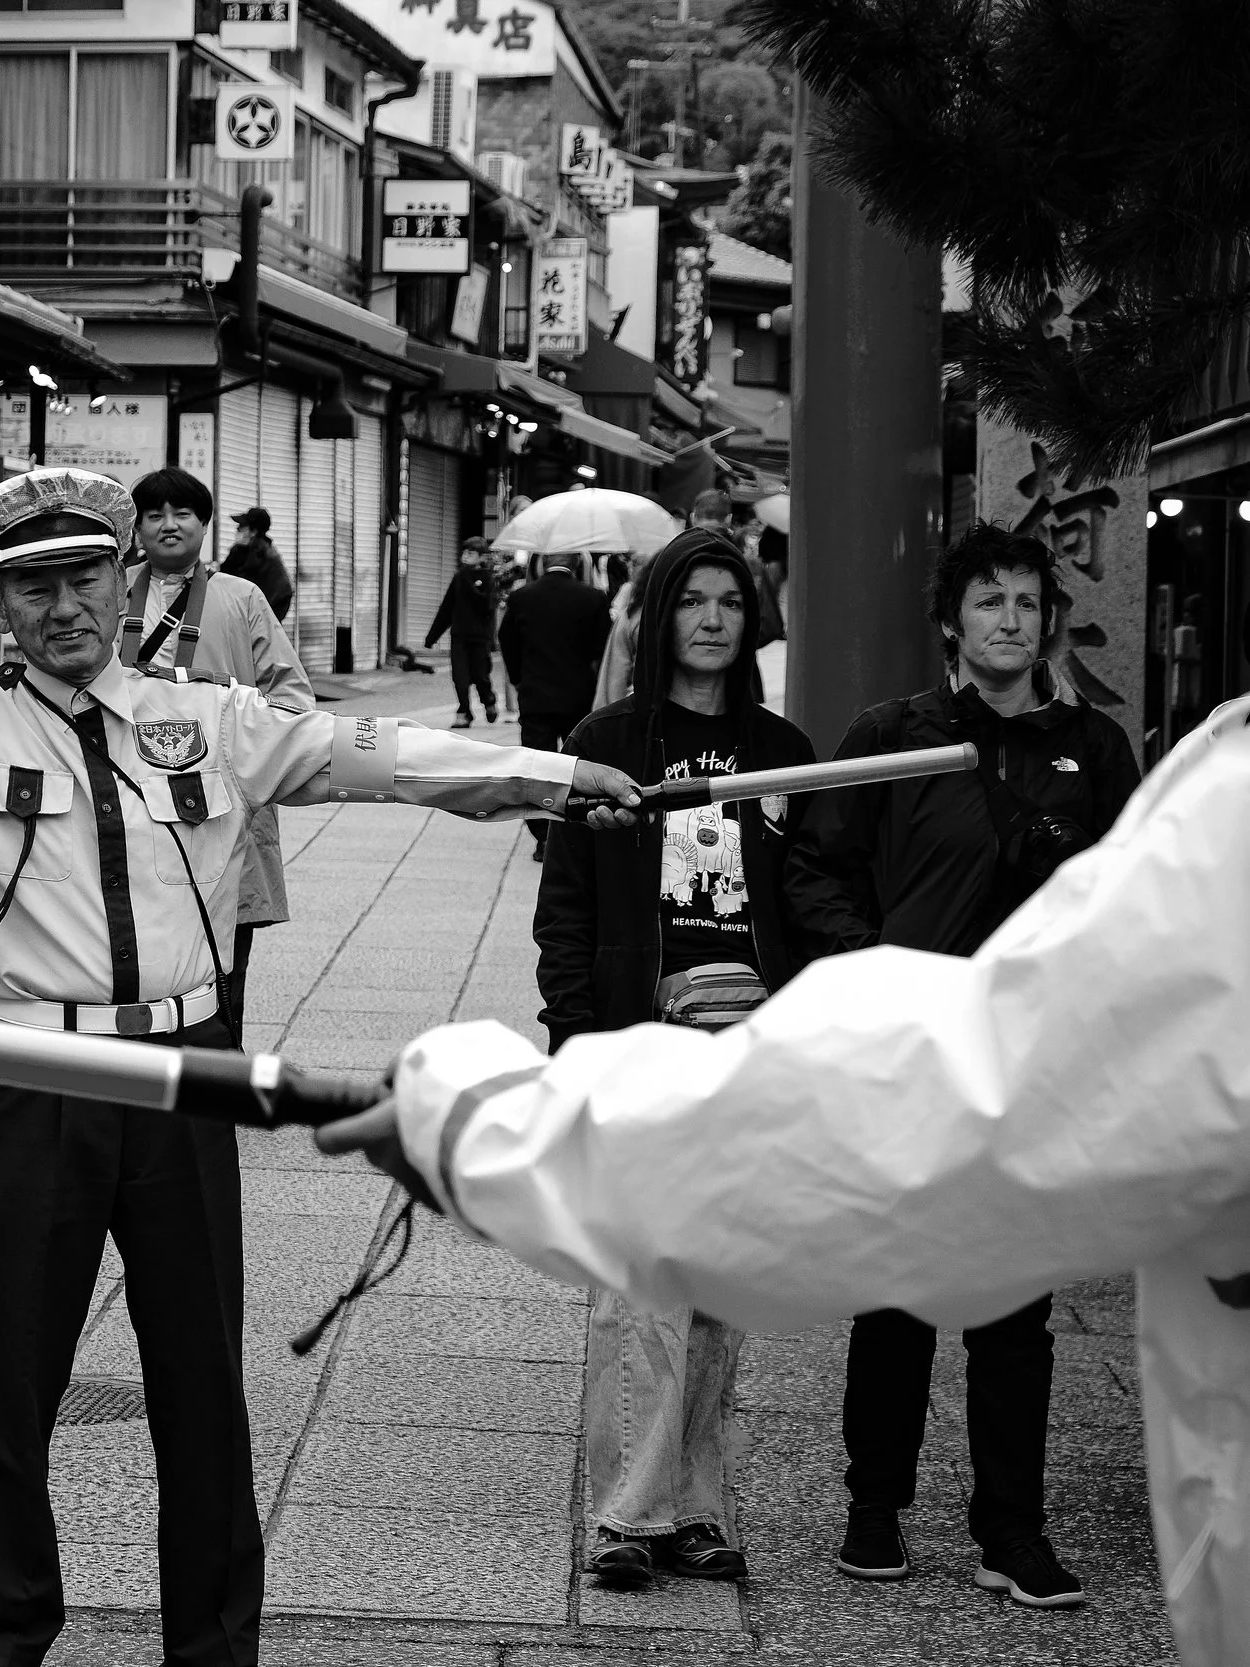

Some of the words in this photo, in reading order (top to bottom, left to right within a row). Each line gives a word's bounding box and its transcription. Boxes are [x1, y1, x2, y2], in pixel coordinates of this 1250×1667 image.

[391, 214, 462, 238] 日野家
[138, 723, 196, 734] 全日本パトロール
[664, 759, 690, 780] ppy
[721, 923, 749, 932] HAVEN
